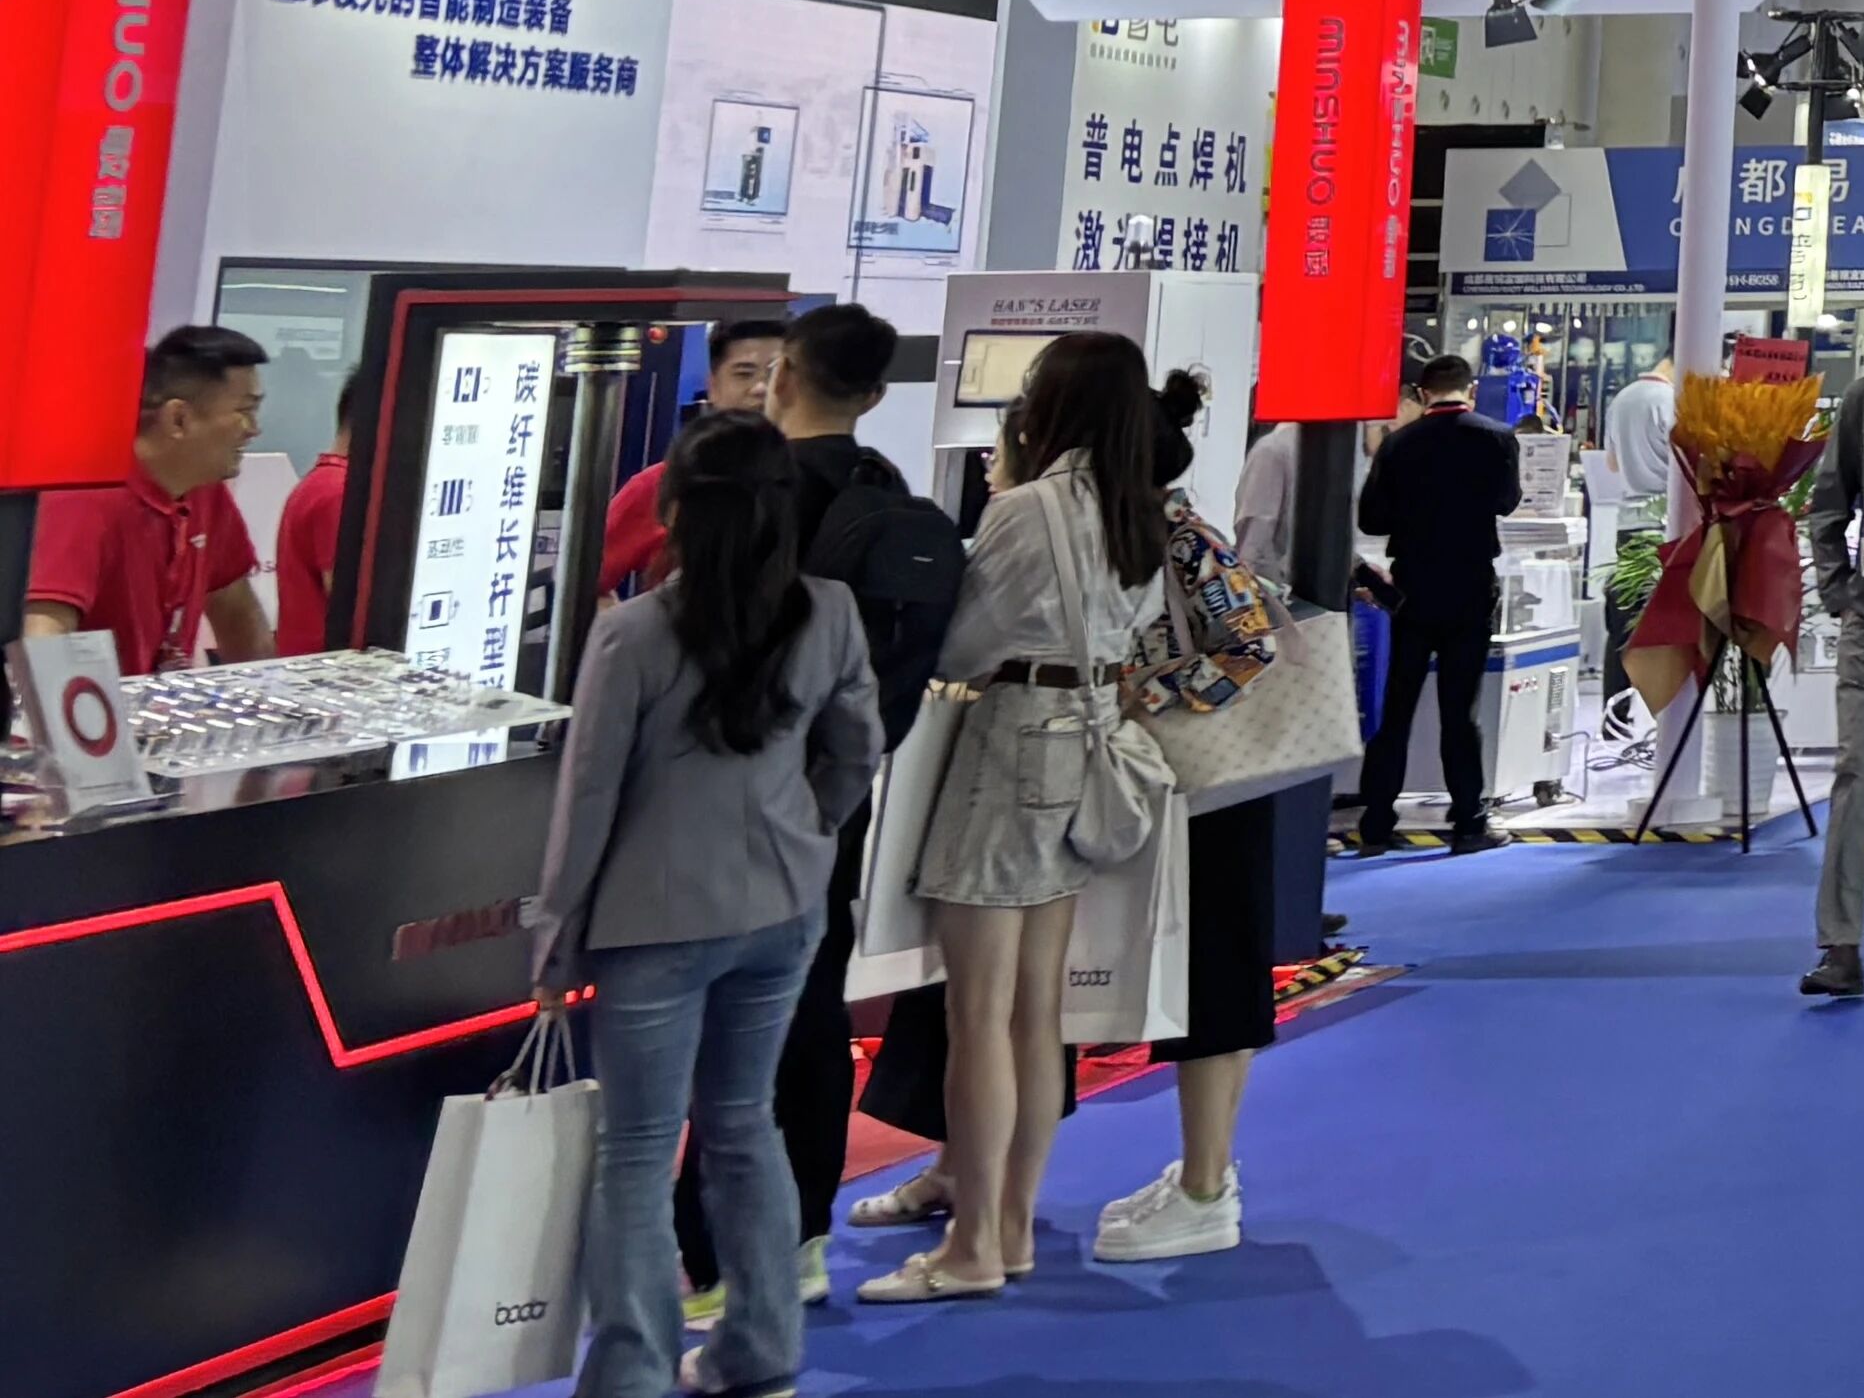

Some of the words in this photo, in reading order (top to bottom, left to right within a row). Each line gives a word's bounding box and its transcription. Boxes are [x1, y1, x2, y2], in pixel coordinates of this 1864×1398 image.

[411, 35, 639, 99] 整体解决方案服务商
[471, 361, 541, 690] 碳纤维长杆型
